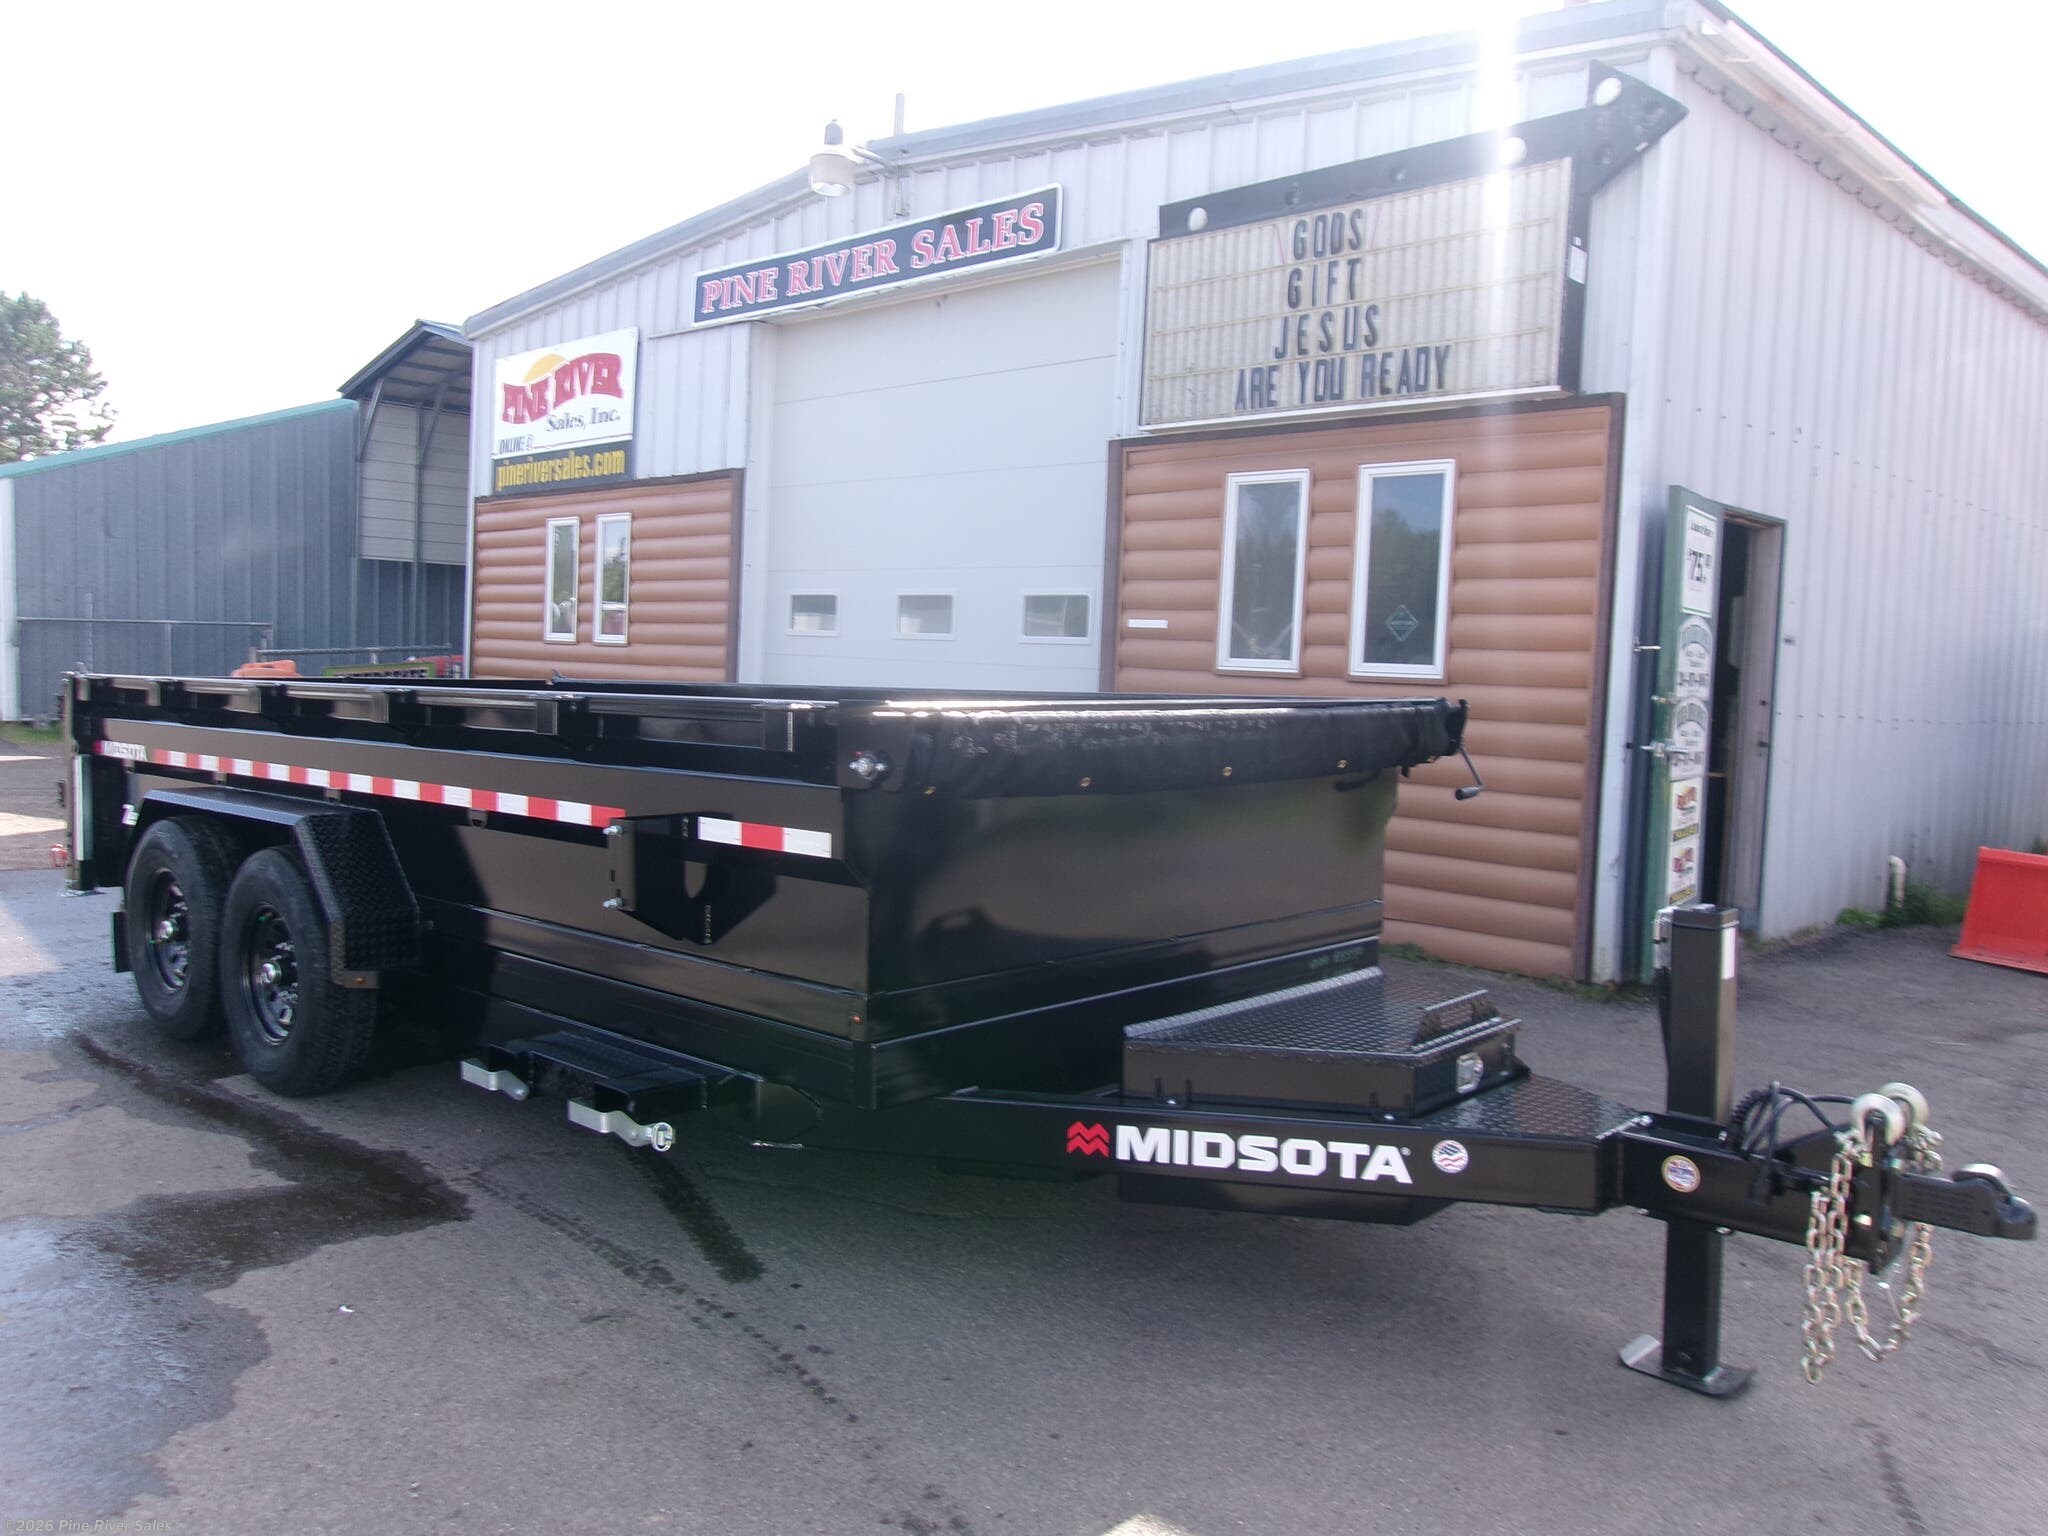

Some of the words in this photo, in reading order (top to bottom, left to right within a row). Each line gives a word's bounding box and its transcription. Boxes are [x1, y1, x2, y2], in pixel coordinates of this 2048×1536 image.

[701, 267, 779, 313] PINE
[786, 239, 900, 296] RIVER
[910, 202, 1045, 269] SALES
[1293, 208, 1363, 260] GODS
[1287, 257, 1362, 309] GIFT
[1274, 304, 1379, 360] JESUS
[502, 374, 551, 424] PINE
[553, 352, 624, 410] RIVER
[1235, 365, 1280, 411] ARE
[1298, 356, 1346, 404] YOU
[1360, 345, 1452, 398] READY
[589, 406, 621, 425] Inc.
[496, 449, 626, 492] pineriversales.com
[1115, 1124, 1414, 1184] MIDSOTA
